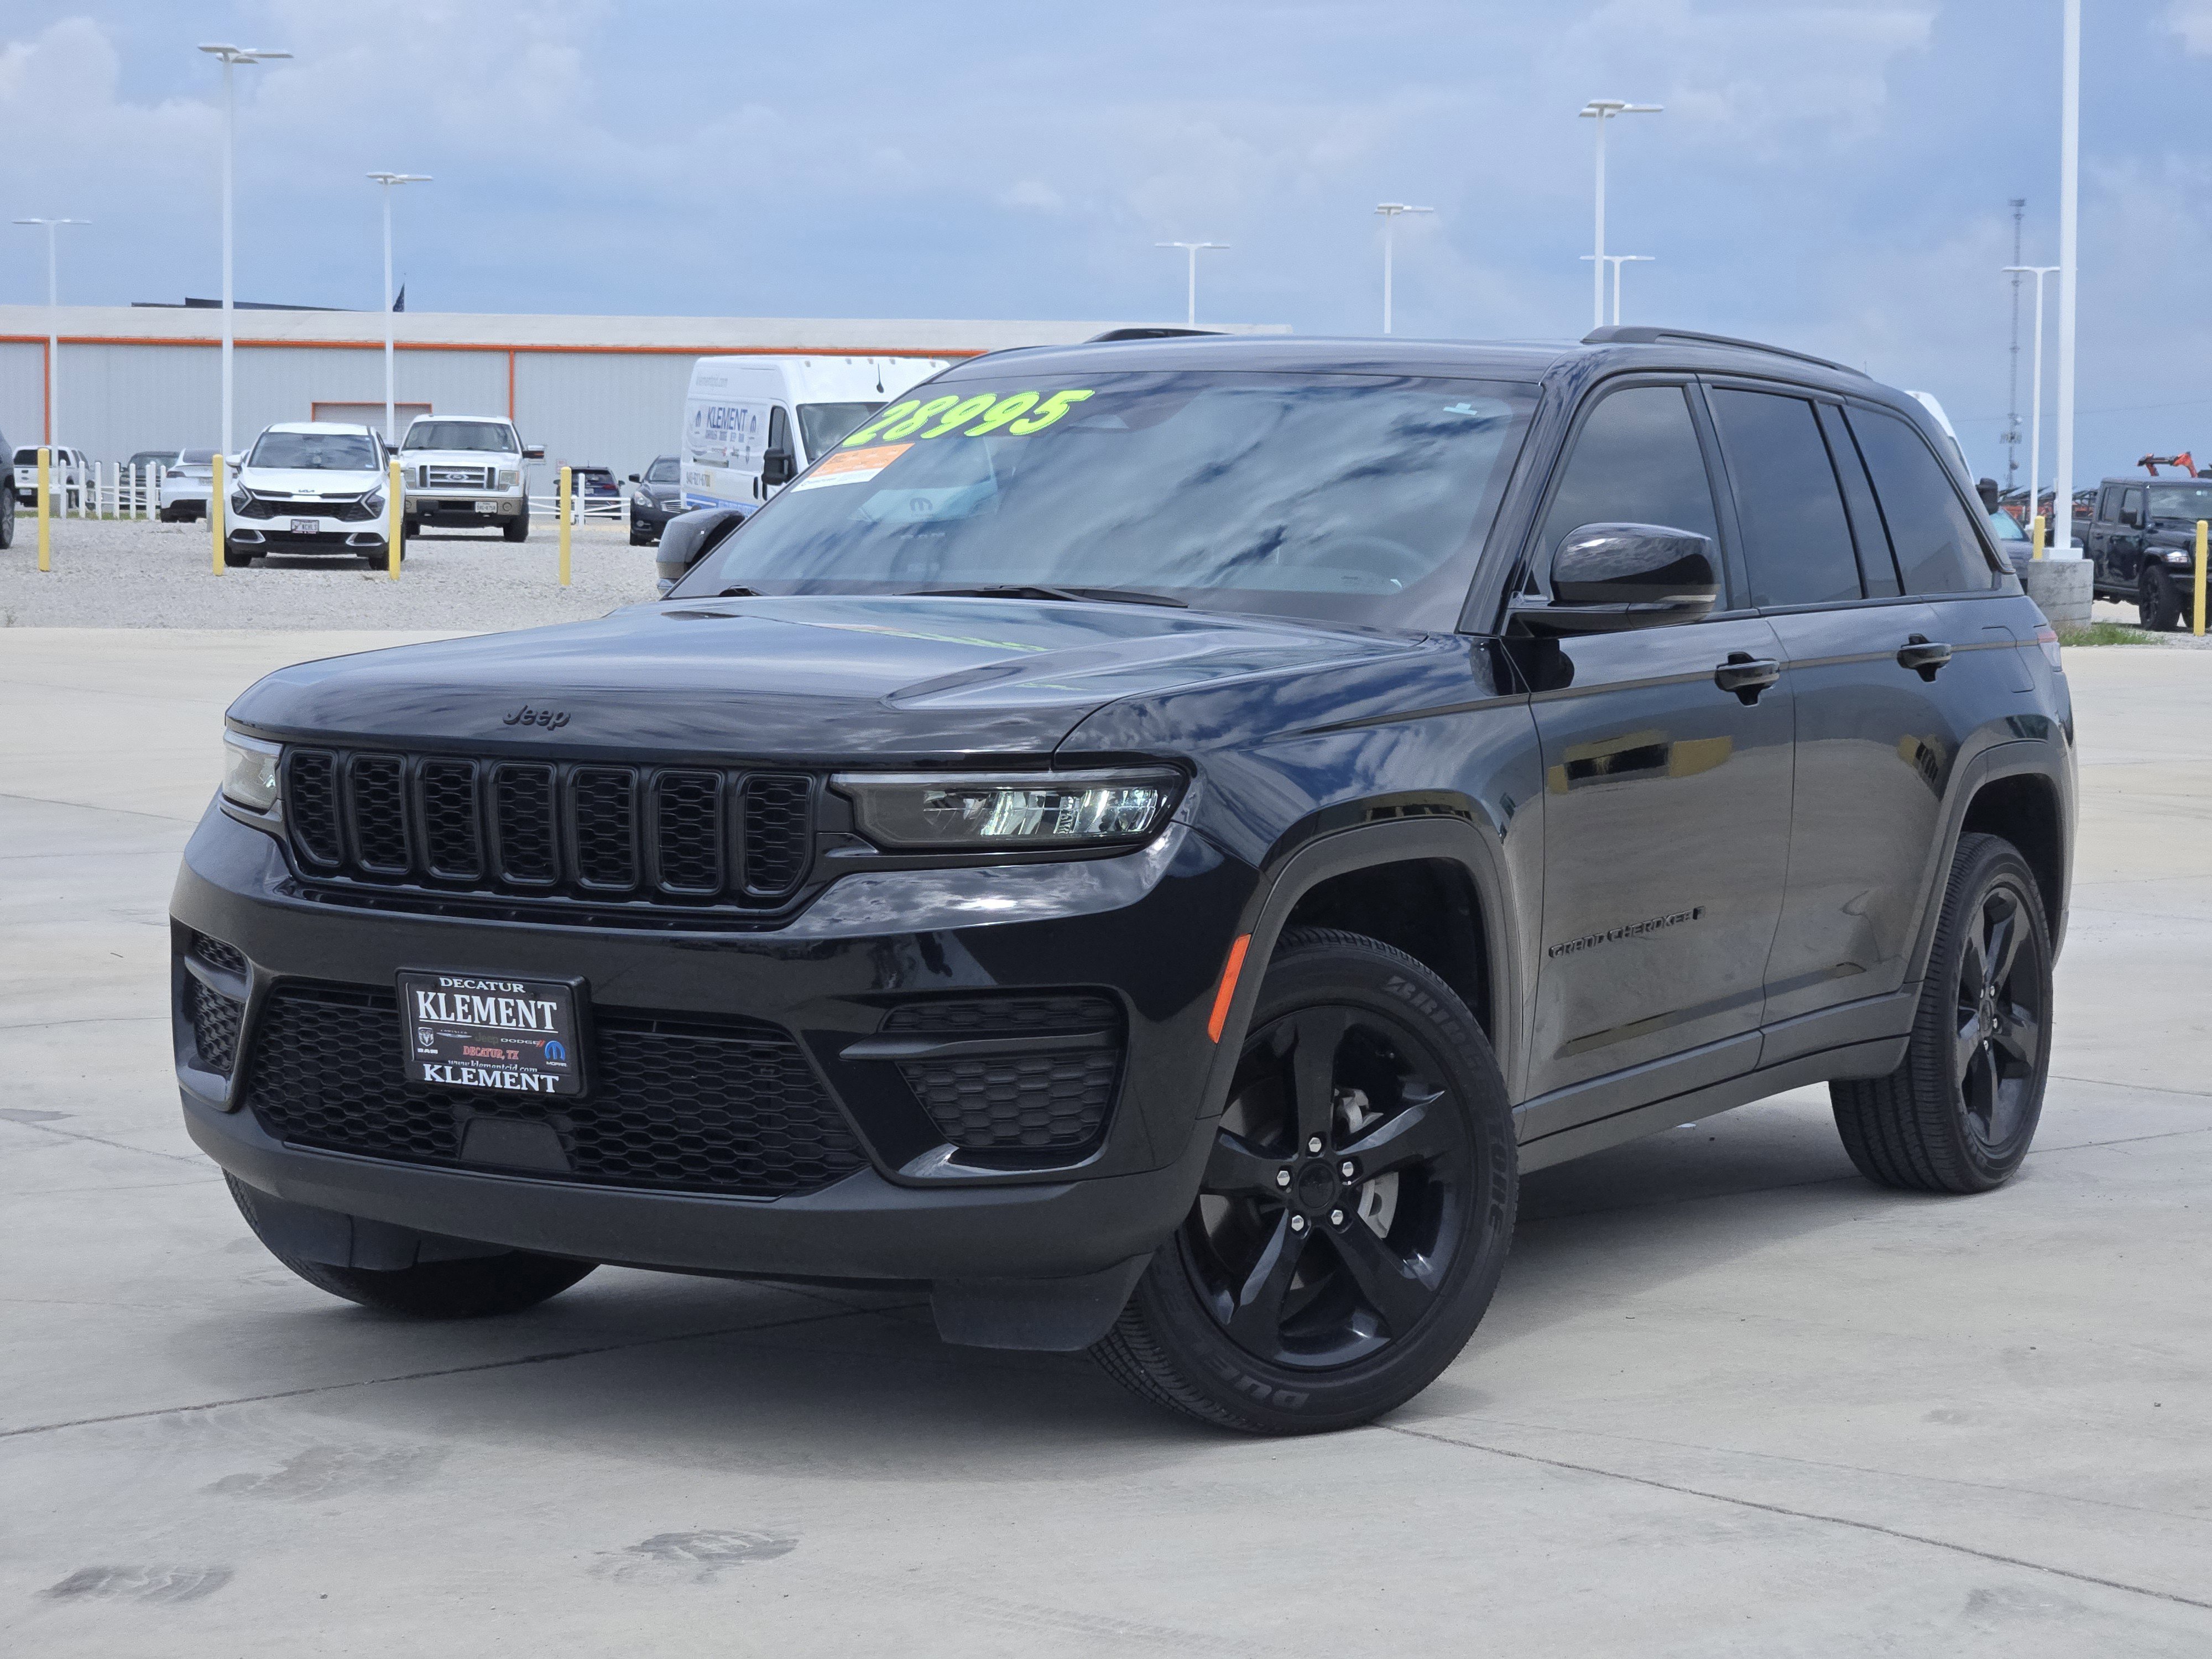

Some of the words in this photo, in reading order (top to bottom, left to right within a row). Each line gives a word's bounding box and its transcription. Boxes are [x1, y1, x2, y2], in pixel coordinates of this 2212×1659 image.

[707, 406, 748, 431] KLEMENT
[842, 389, 1095, 448] 28995
[502, 705, 571, 731] Jeep
[1548, 932, 1604, 958] GRAND
[1606, 906, 1704, 942] CHEROKEE
[439, 977, 526, 993] DECATUR
[416, 990, 557, 1030] KLEMENT
[462, 1045, 505, 1060] DECATUR,
[506, 1050, 519, 1060] TX
[423, 1063, 559, 1093] KLEMENT
